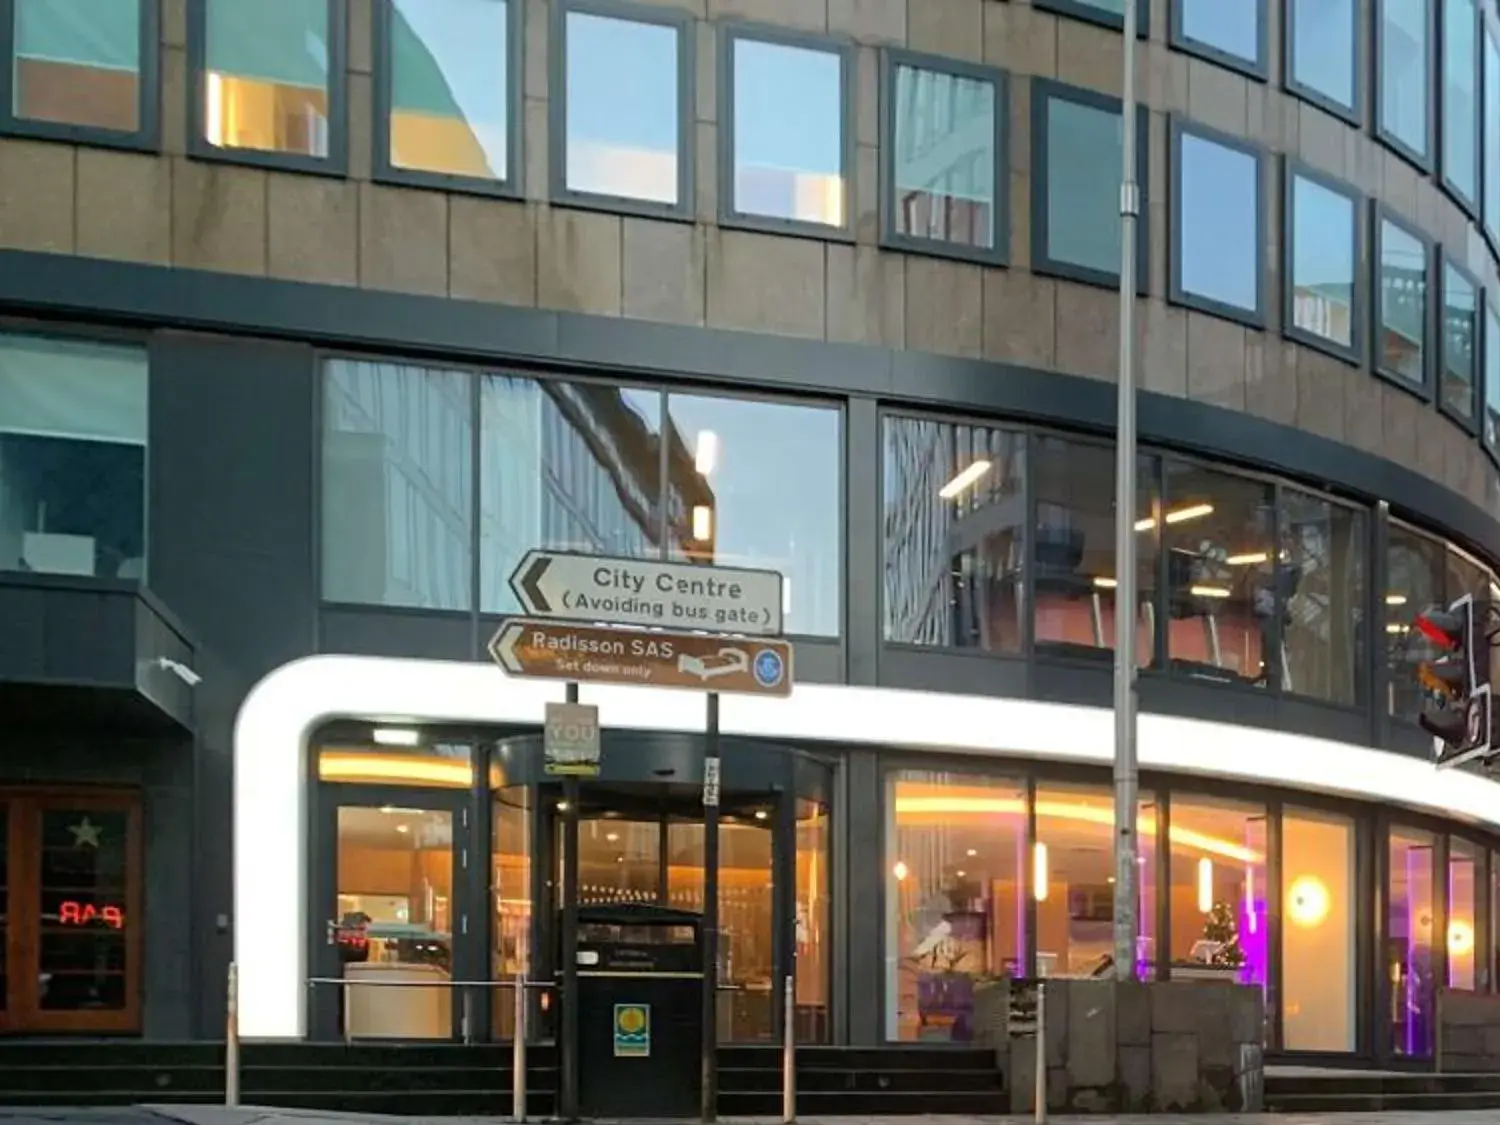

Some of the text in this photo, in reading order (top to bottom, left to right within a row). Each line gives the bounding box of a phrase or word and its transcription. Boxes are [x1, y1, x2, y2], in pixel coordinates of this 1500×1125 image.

[594, 567, 742, 599] City Centre
[561, 590, 771, 625] (Avoiding bus gate)
[533, 631, 674, 659] Radisson SAS
[556, 657, 652, 680] Set down only
